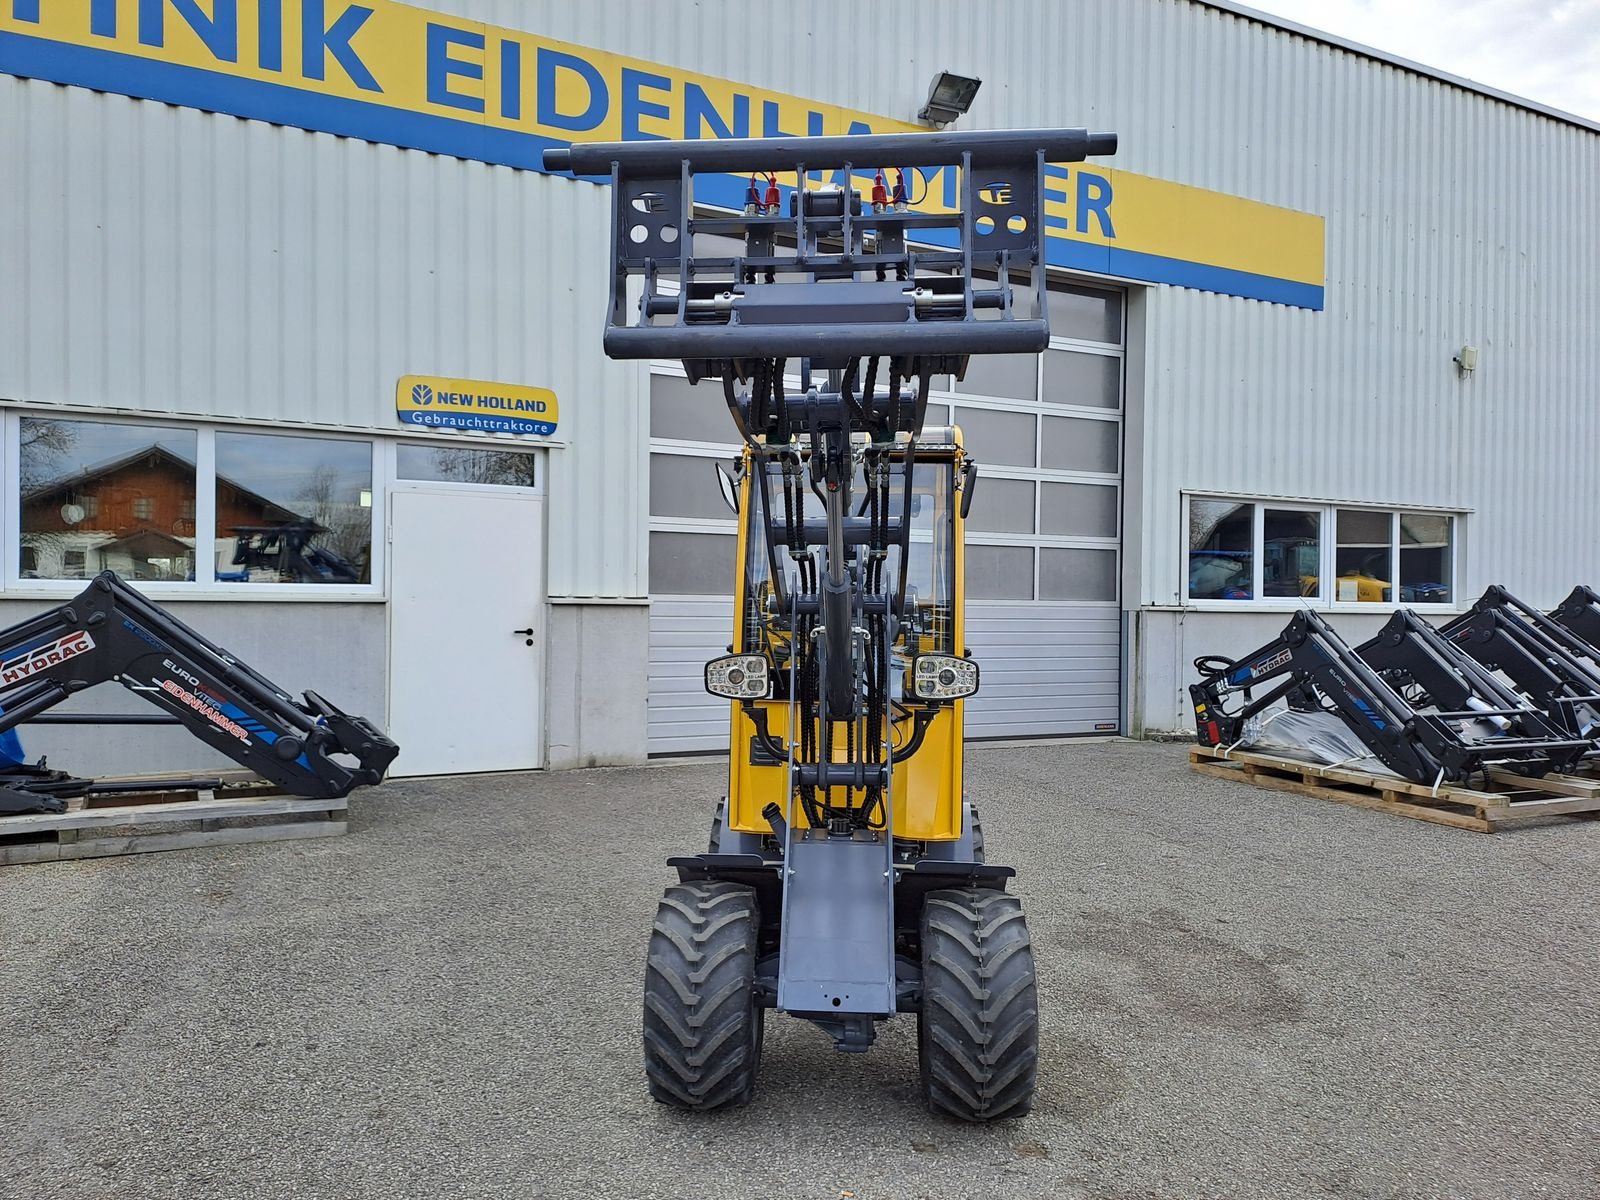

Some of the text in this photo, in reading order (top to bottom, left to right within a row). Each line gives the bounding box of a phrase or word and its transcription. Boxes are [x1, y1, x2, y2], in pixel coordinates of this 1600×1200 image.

[437, 391, 547, 413] NEW HOLLAND
[411, 411, 548, 433] Gebrauchttraktore
[2, 640, 89, 683] HYDRAC
[162, 658, 200, 687] EURO
[1257, 653, 1292, 675] HYDRAC
[1328, 668, 1347, 687] EURO
[162, 679, 249, 740] EIDENHAMMER
